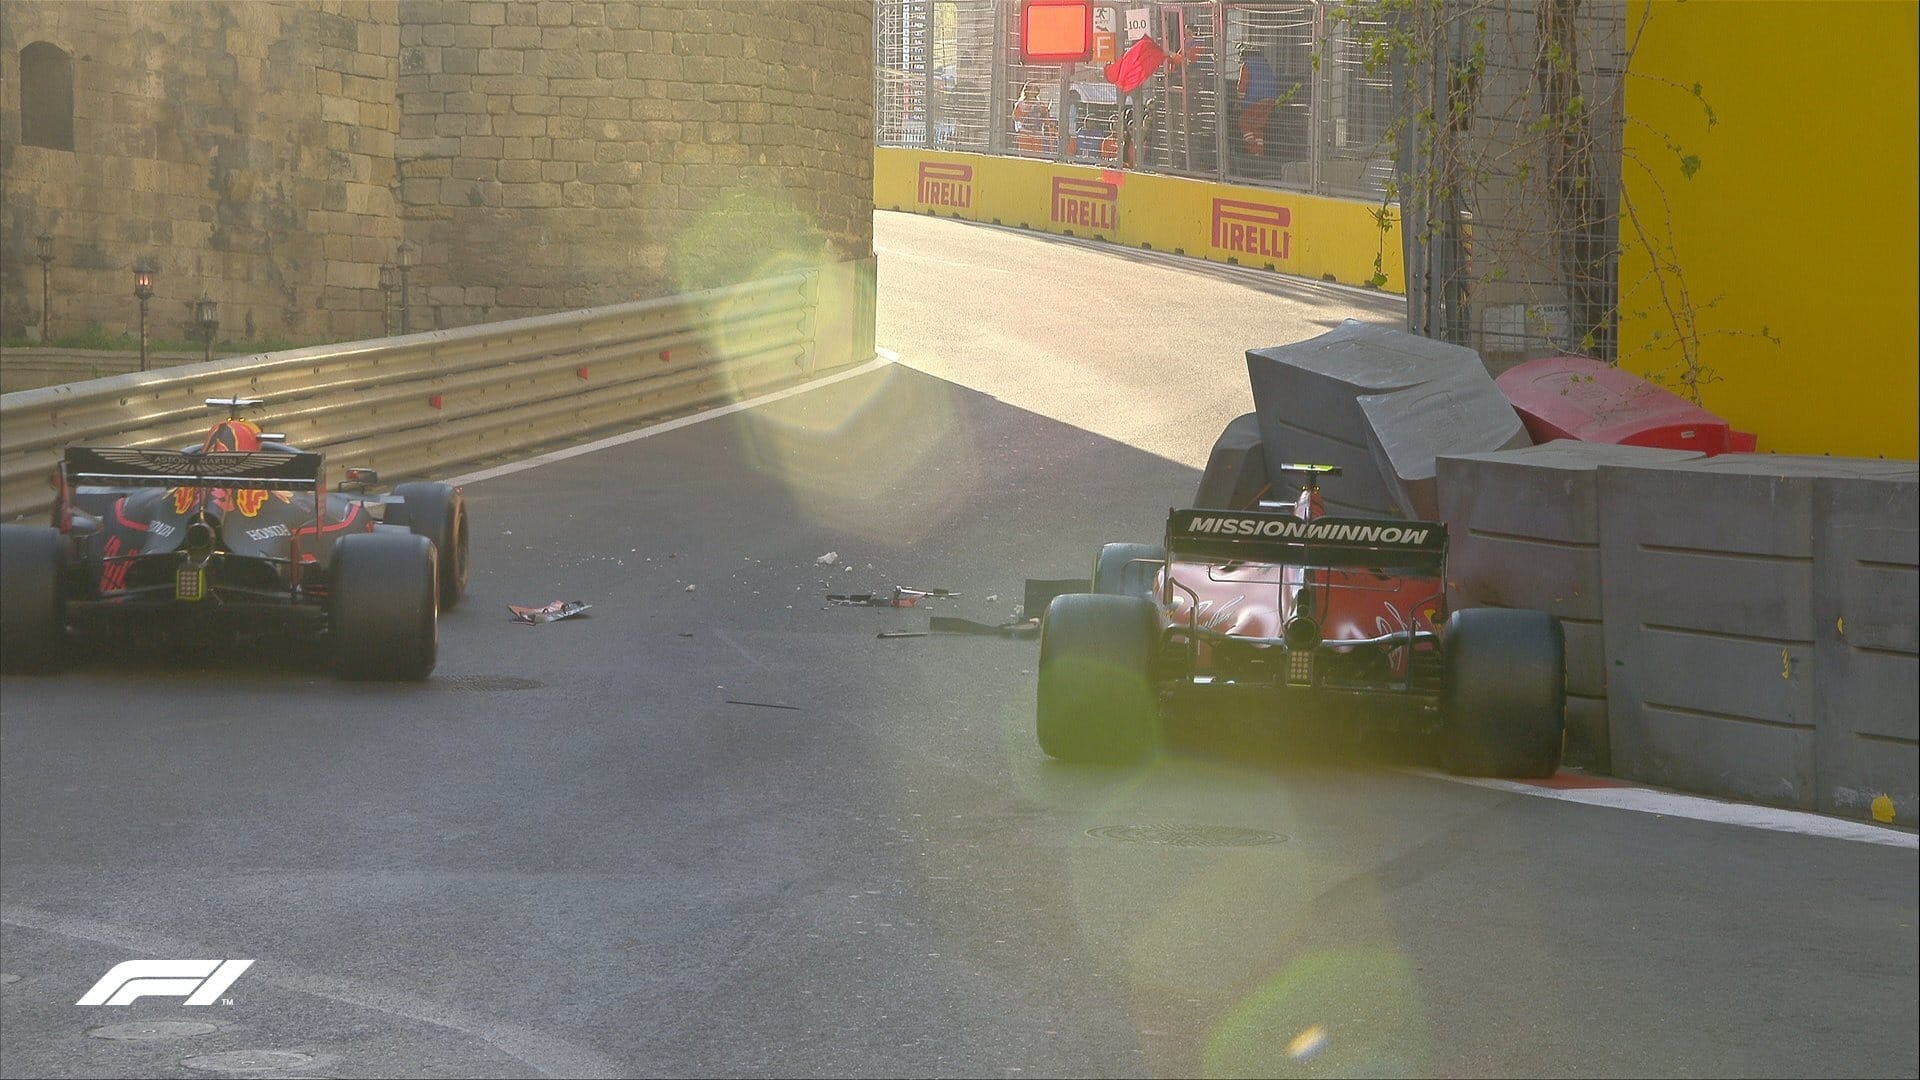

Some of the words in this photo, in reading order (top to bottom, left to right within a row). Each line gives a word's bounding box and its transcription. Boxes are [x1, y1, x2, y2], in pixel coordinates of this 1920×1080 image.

[1128, 19, 1147, 30] 10.0
[1097, 36, 1111, 58] F
[918, 161, 973, 208] PIRELLI
[1051, 176, 1118, 230] PIRELLI
[1211, 197, 1291, 259] PIRELLI
[153, 456, 190, 464] ASTON
[199, 456, 237, 465] MARTIN
[245, 523, 292, 540] HONDA
